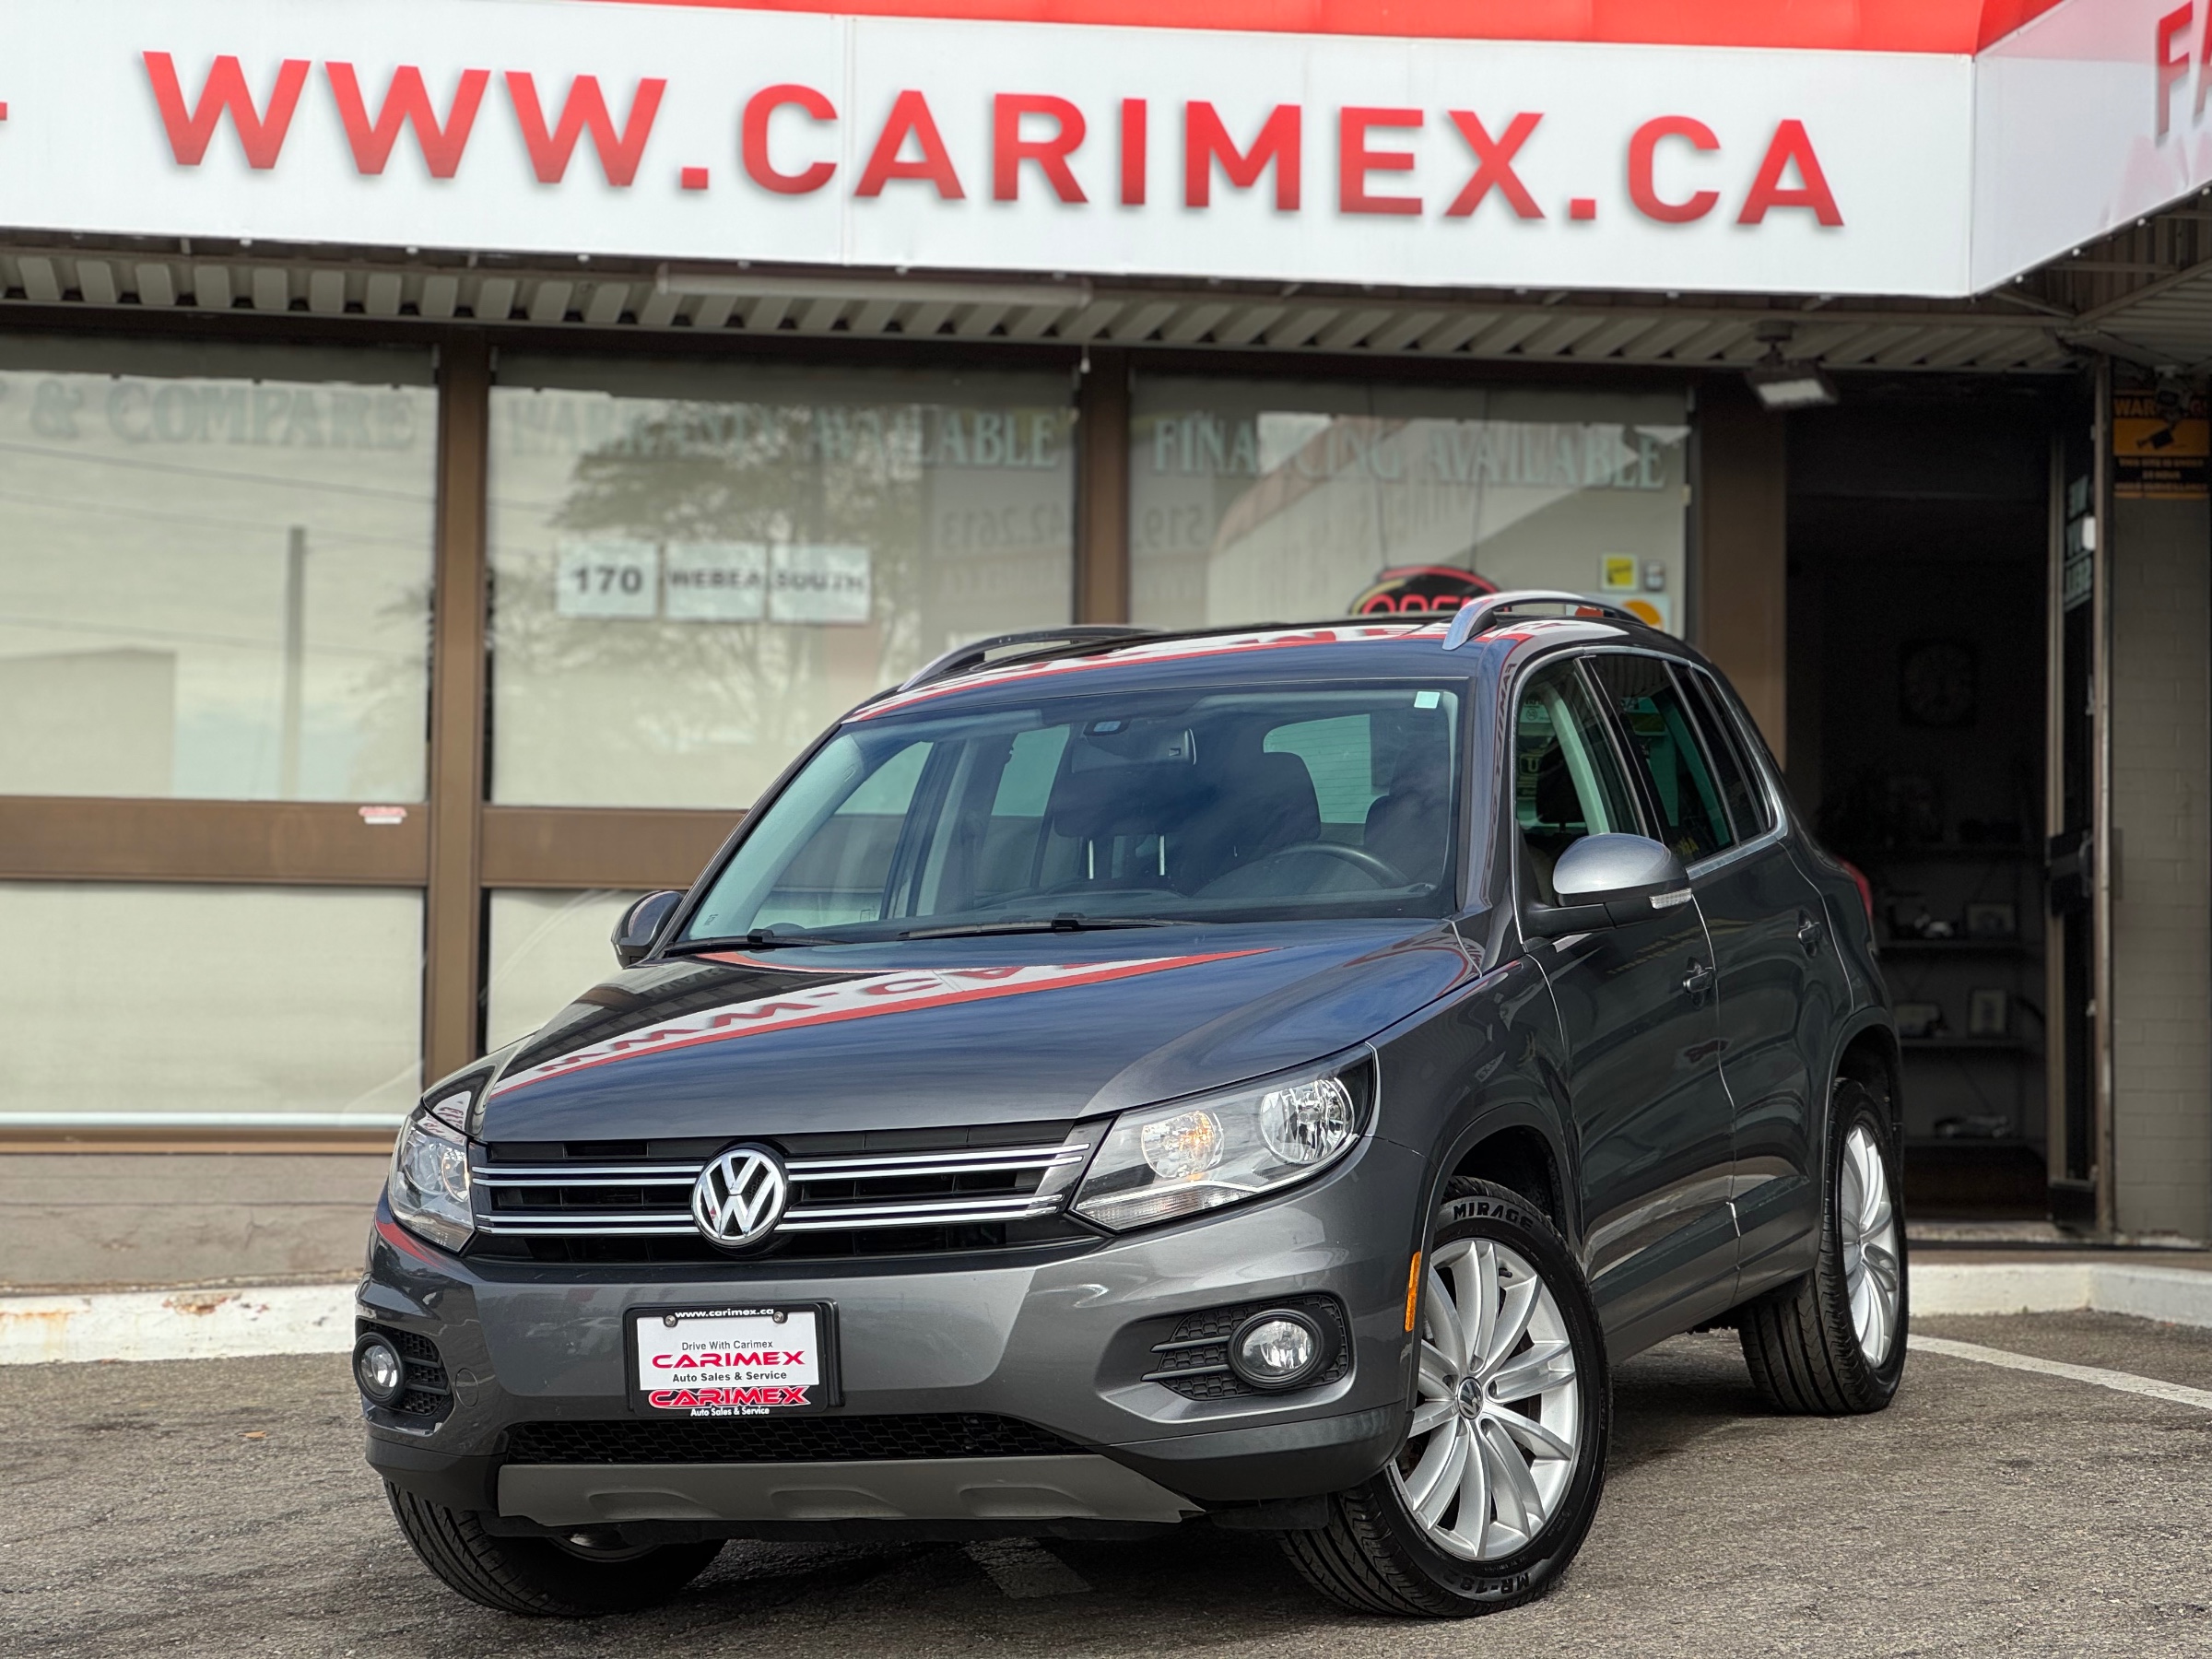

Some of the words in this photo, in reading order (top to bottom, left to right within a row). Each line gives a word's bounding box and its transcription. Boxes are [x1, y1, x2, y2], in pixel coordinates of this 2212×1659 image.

[142, 51, 1845, 227] WWW.CARIMEX.CA
[29, 379, 84, 441] &
[106, 382, 416, 451] COMPARE
[1152, 418, 1404, 480] FINACING
[1427, 423, 1665, 488] AVAILABLE
[574, 565, 644, 594] 170
[1453, 1201, 1535, 1232] MIRAGE
[675, 1308, 774, 1318] www.carimex.ca
[682, 1342, 706, 1351] Drive
[709, 1341, 731, 1350] With
[734, 1339, 773, 1349] Carimex
[652, 1350, 806, 1369] CARIMEX
[673, 1373, 698, 1382] Auto
[700, 1371, 731, 1382] Sales
[734, 1371, 742, 1381] &
[746, 1370, 787, 1381] Service
[648, 1386, 810, 1408] CARIMEX
[690, 1407, 709, 1417] Auto
[711, 1407, 732, 1417] Sales
[734, 1407, 740, 1416] &
[742, 1406, 770, 1416] Service
